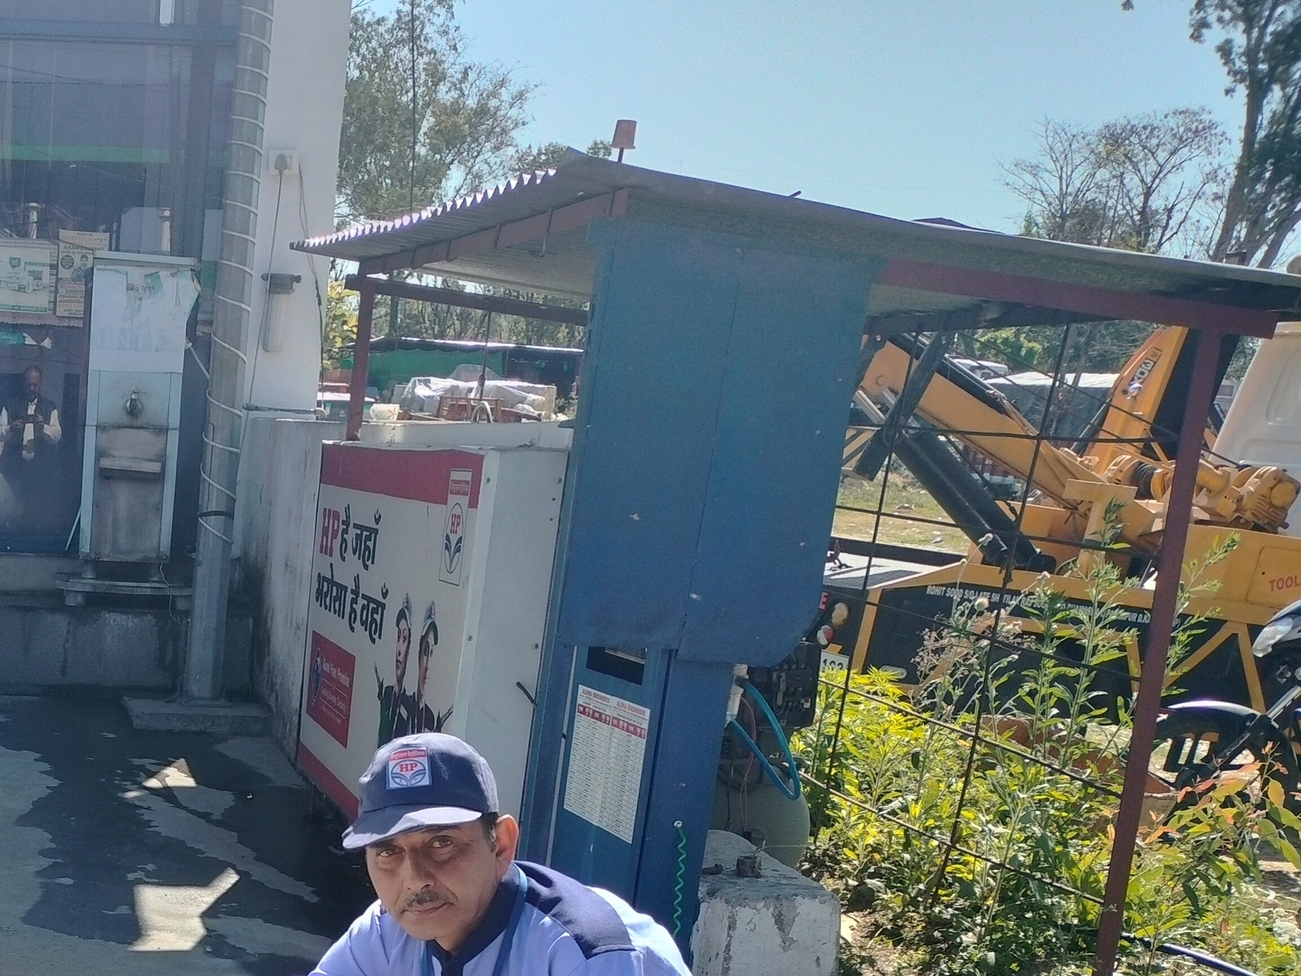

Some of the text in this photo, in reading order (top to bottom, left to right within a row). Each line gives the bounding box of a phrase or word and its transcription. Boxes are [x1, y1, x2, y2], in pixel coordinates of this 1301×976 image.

[450, 513, 461, 535] HP
[319, 504, 382, 571] HP है जहाँ
[926, 585, 946, 596] ROHIT
[1268, 575, 1301, 592] TOOL
[315, 563, 389, 645] भरोसा है वहाँ
[399, 762, 418, 772] HP
